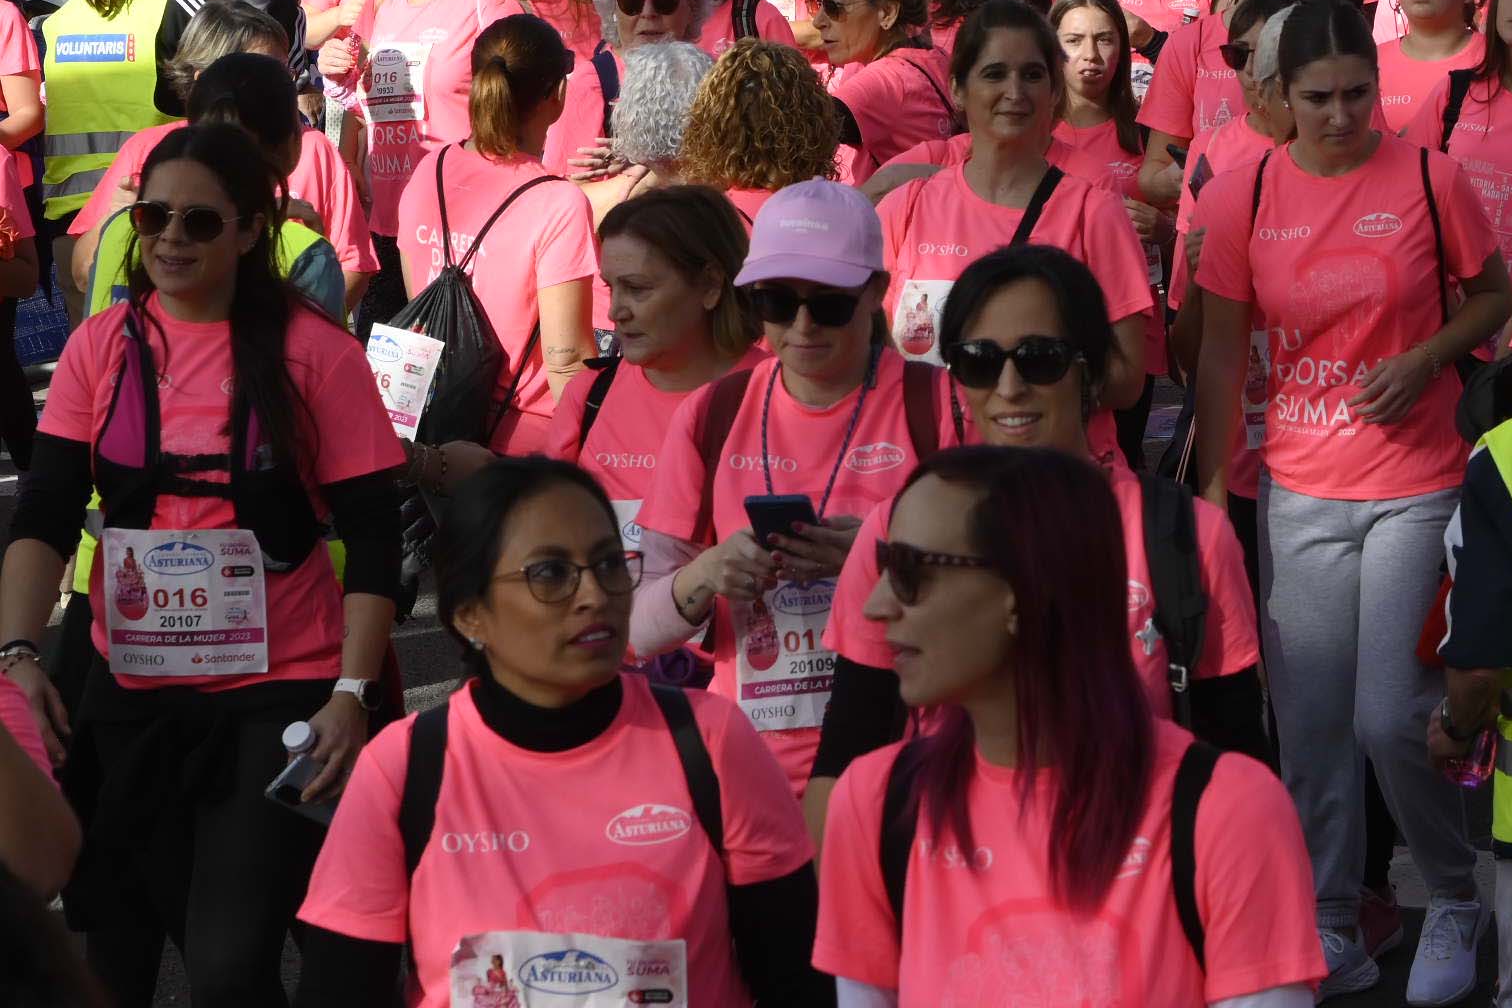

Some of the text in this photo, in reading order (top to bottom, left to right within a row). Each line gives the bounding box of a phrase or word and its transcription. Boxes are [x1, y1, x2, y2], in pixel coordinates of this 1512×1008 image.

[56, 41, 124, 56] VOLUNTARIS
[374, 71, 397, 84] 016
[1259, 225, 1311, 241] OYSHO
[917, 242, 968, 257] OYSHO
[1275, 393, 1352, 426] SUMA
[148, 554, 210, 568] ASTURIANA
[152, 587, 209, 609] 016
[159, 614, 202, 628] 20107
[125, 633, 163, 643] CARRERA
[164, 635, 177, 643] DE
[179, 634, 192, 642] LA
[193, 633, 226, 642] MUJER
[783, 628, 827, 653] 01
[122, 652, 256, 666] OYSHO Santander
[789, 657, 834, 675] 20109
[751, 704, 796, 721] OYSHO
[613, 818, 687, 838] ASTURIANA
[440, 830, 530, 854] OYSHO
[526, 965, 611, 985] ASTURIANA
